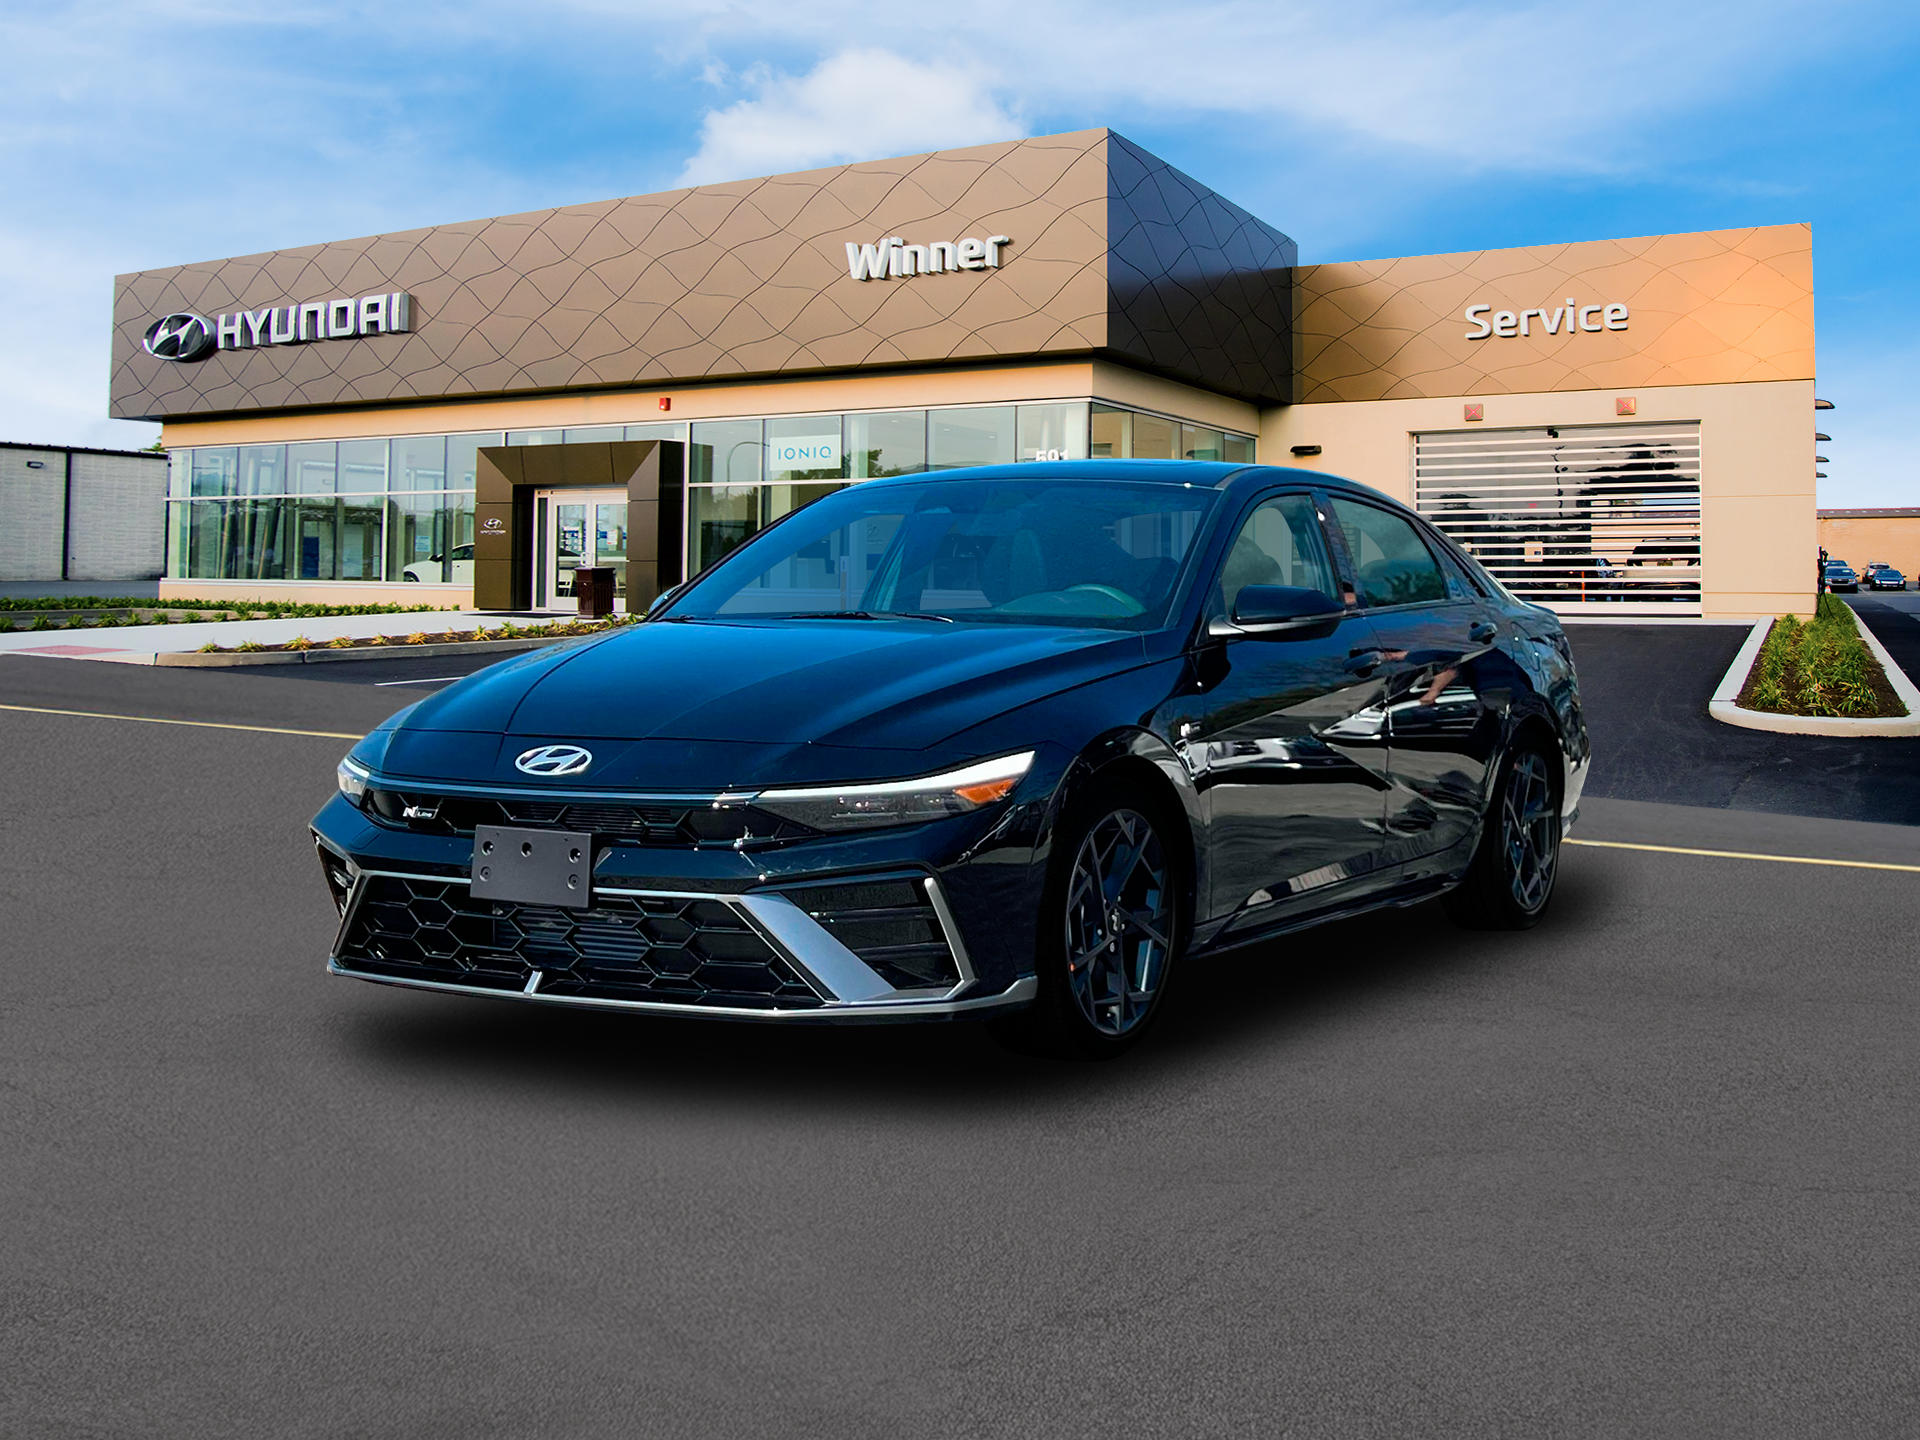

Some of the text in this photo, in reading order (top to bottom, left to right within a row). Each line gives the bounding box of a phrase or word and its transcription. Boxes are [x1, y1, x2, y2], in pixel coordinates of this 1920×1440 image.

[845, 235, 1009, 281] Winner
[217, 292, 409, 350] HYUNDAI
[1465, 297, 1629, 340] Service
[778, 445, 832, 460] IONIQ
